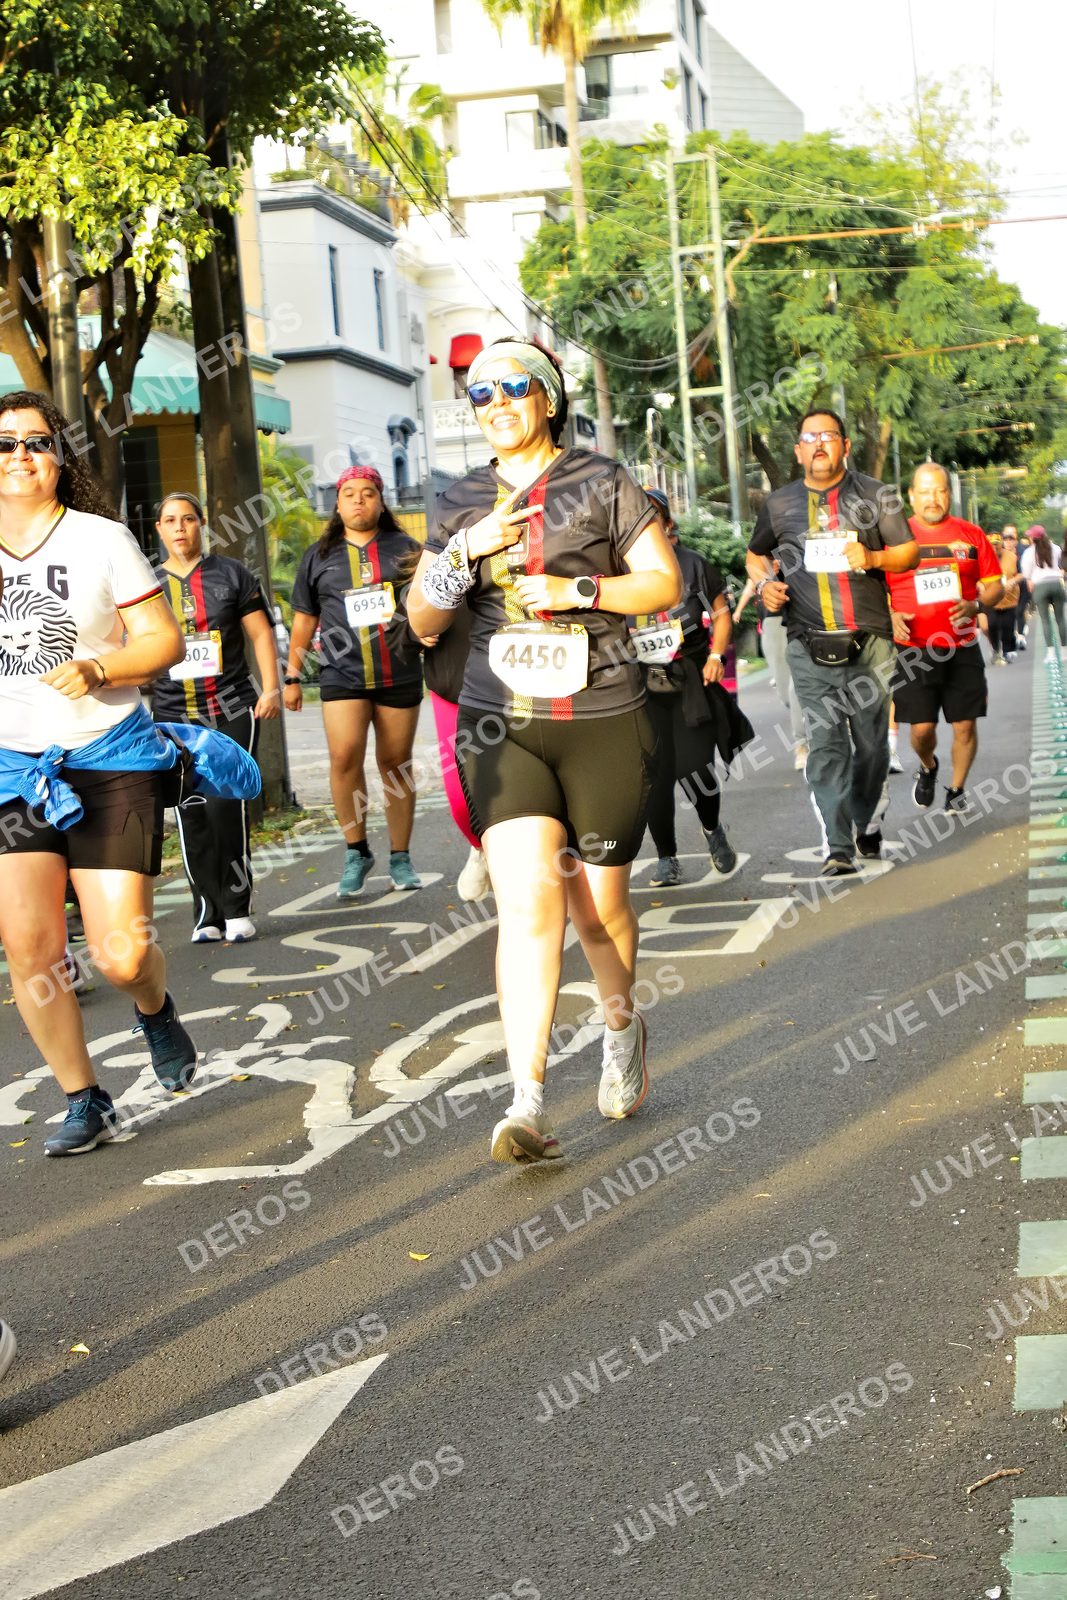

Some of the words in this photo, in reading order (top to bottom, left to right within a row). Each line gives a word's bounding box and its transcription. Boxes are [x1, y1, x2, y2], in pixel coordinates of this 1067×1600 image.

[47, 565, 69, 600] G
[922, 576, 951, 590] 3639
[353, 596, 386, 612] 6954
[639, 635, 673, 653] 3320
[184, 647, 210, 662] 602
[501, 644, 567, 670] 4450
